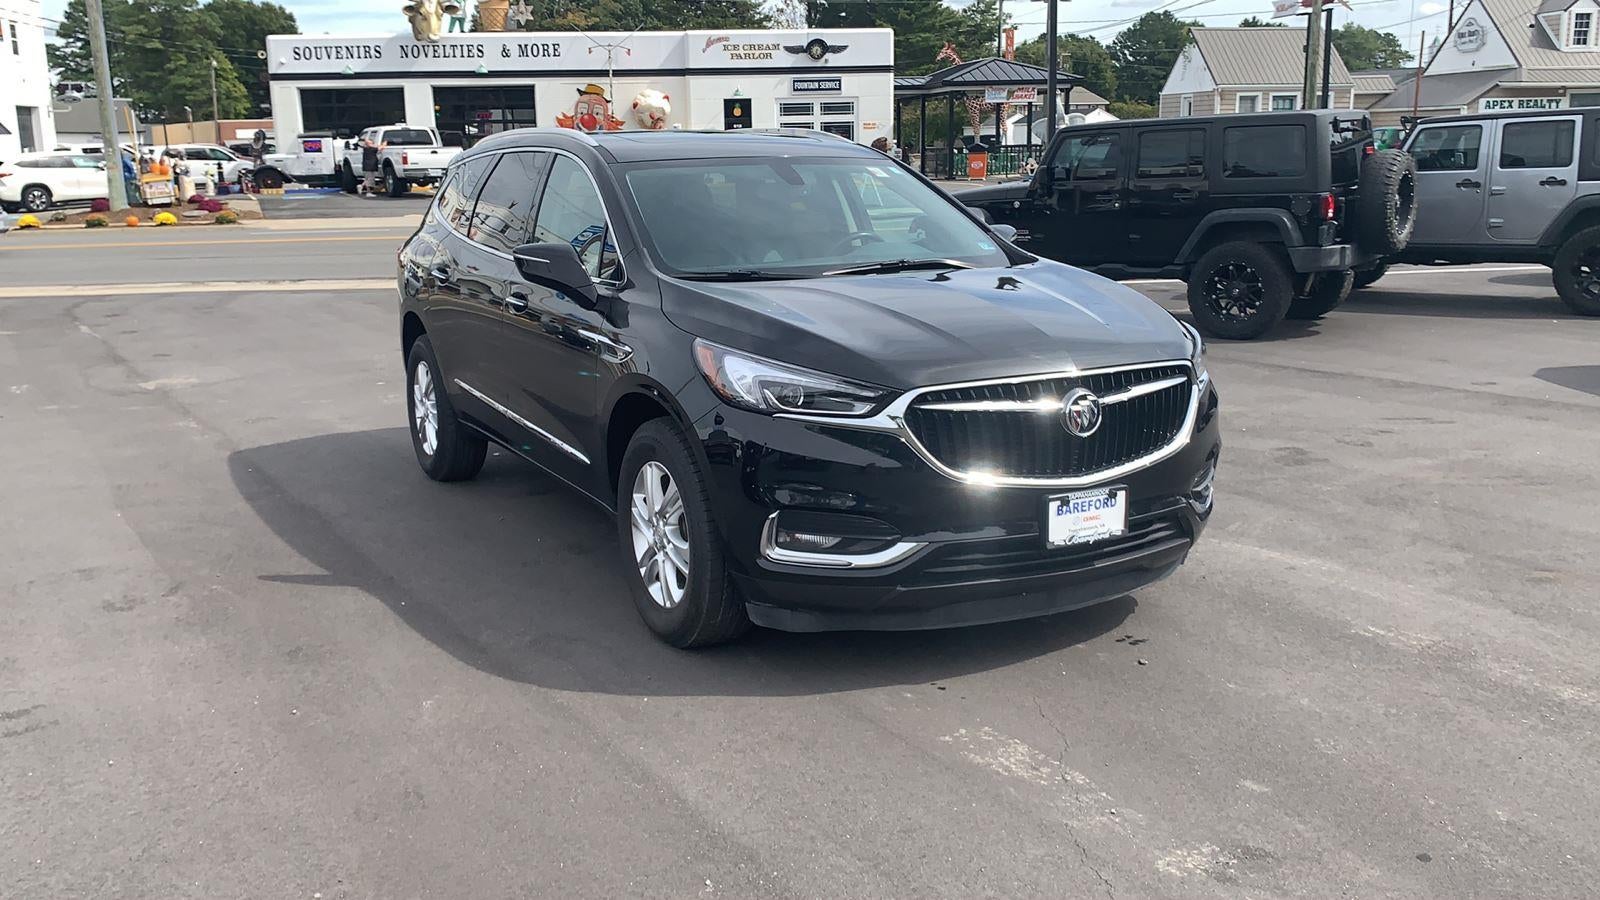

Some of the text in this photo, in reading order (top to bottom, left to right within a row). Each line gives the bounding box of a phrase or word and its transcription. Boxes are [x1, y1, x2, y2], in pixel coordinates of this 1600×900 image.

[293, 43, 561, 61] SOUVENIRS NOVELTIES & MORE
[723, 43, 780, 51] ICE CREAM
[730, 52, 773, 60] PARLOR
[794, 81, 840, 90] FOUNTAIN SERVICE
[1484, 98, 1562, 110] APEX REALTY
[1056, 497, 1117, 517] BAREFORD
